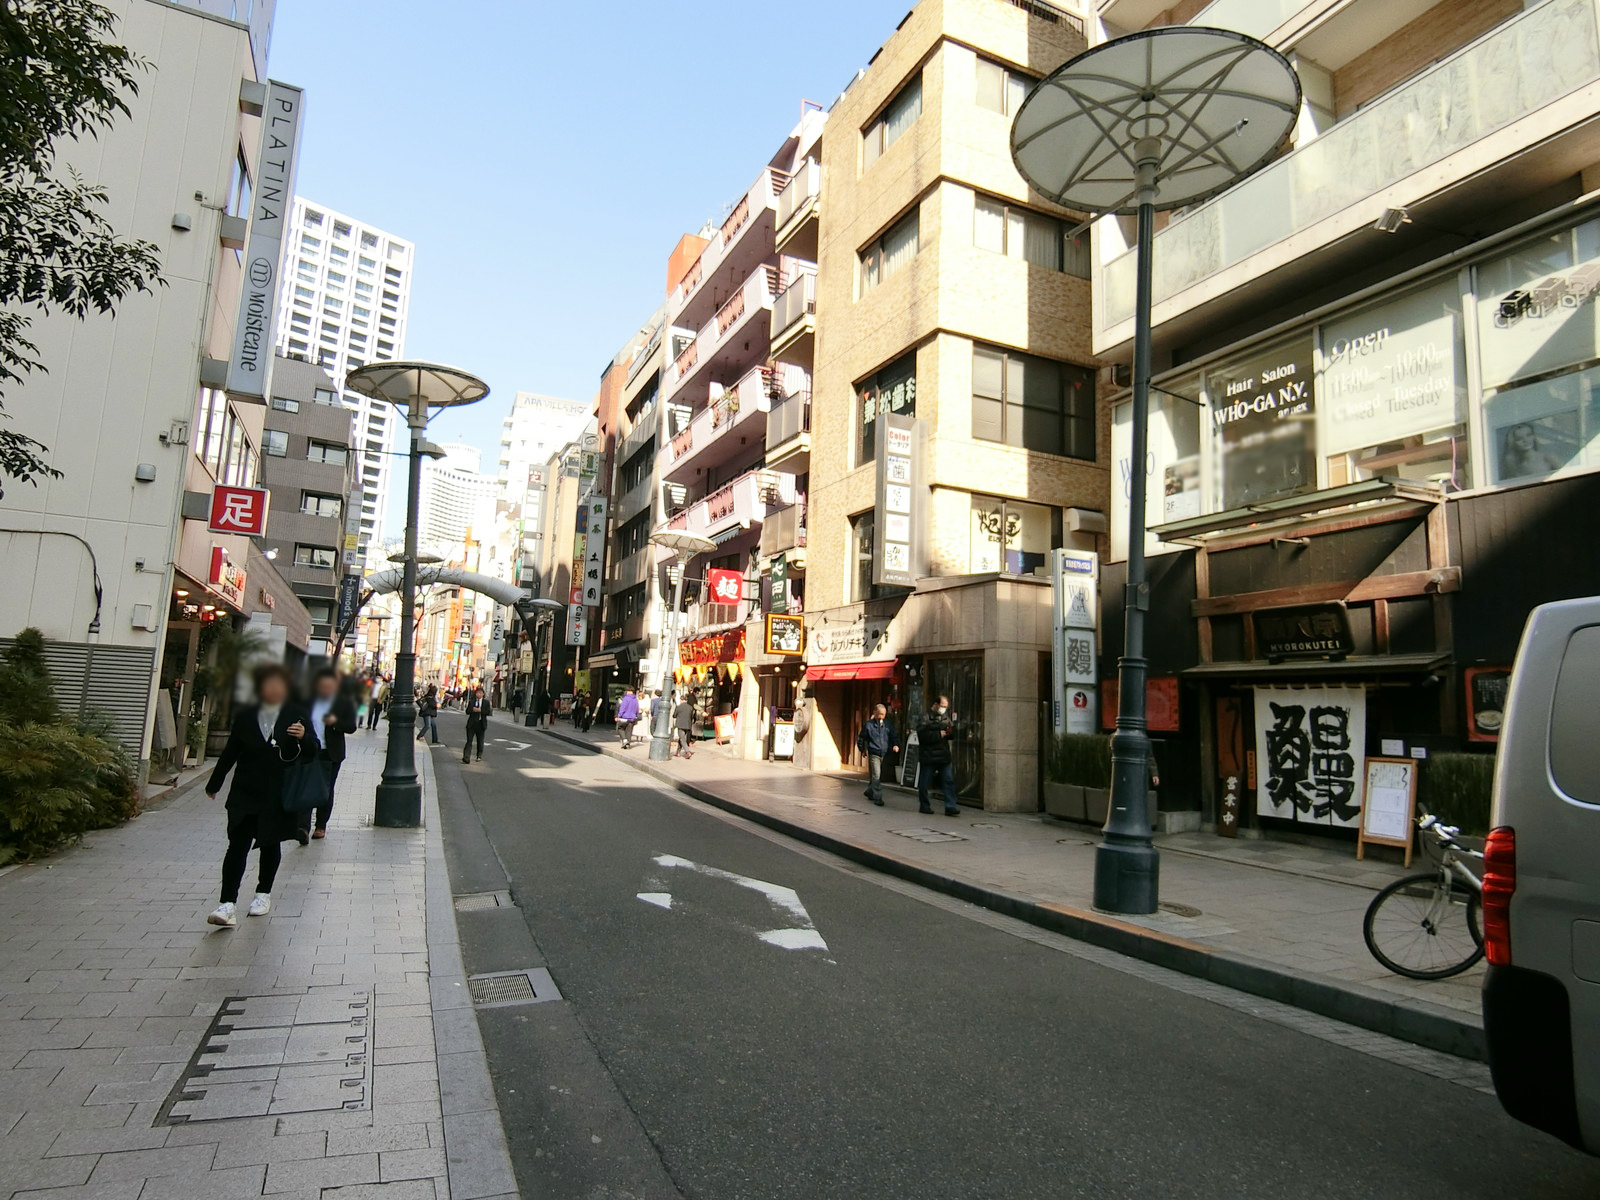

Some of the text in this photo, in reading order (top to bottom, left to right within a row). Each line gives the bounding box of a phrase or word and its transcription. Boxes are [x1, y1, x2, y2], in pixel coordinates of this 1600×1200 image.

[259, 97, 293, 221] PLATINA
[241, 291, 268, 372] Moisteane
[1331, 328, 1389, 358] Open
[1226, 363, 1296, 397] Hair Salon
[1391, 376, 1451, 401] Tuesday
[524, 397, 542, 407] APA
[1214, 381, 1308, 425] WHO-GA N.Y.
[889, 431, 910, 442] Color
[218, 492, 254, 528] 足
[1166, 501, 1175, 511] 2F
[344, 585, 355, 617] Tomod's
[715, 576, 739, 599] 麺
[573, 605, 583, 643] Can Do
[1066, 636, 1093, 676] 鰻
[1265, 701, 1362, 822] 鰻
[1222, 775, 1239, 826] 営業中
